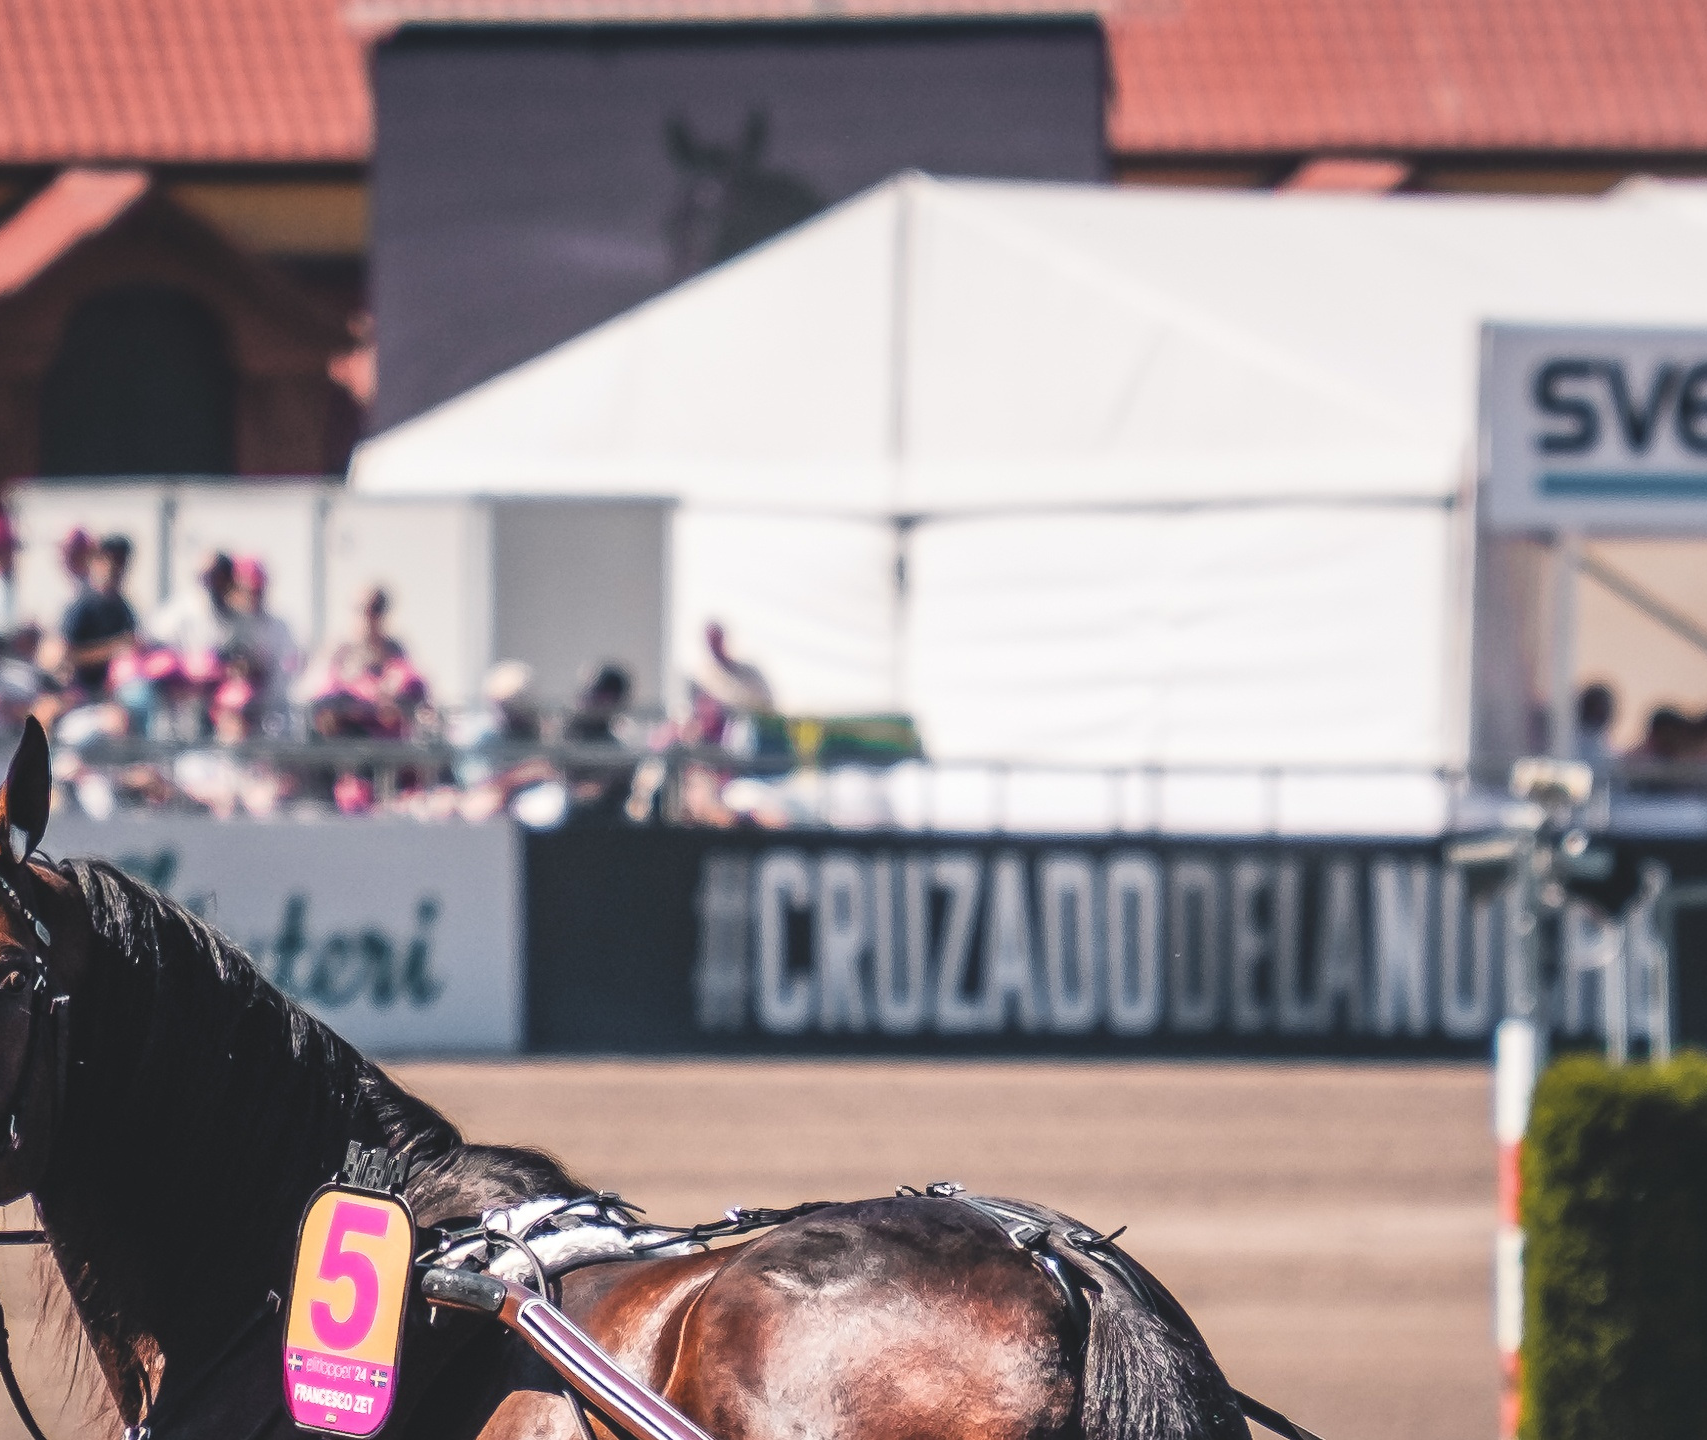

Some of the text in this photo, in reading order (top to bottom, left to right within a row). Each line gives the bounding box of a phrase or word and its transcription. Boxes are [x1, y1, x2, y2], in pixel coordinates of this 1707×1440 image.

[696, 849, 1670, 1036] #CRUZADODELANOHE
[310, 1200, 390, 1351] 5
[293, 1382, 375, 1415] FRANCESCO ZET
